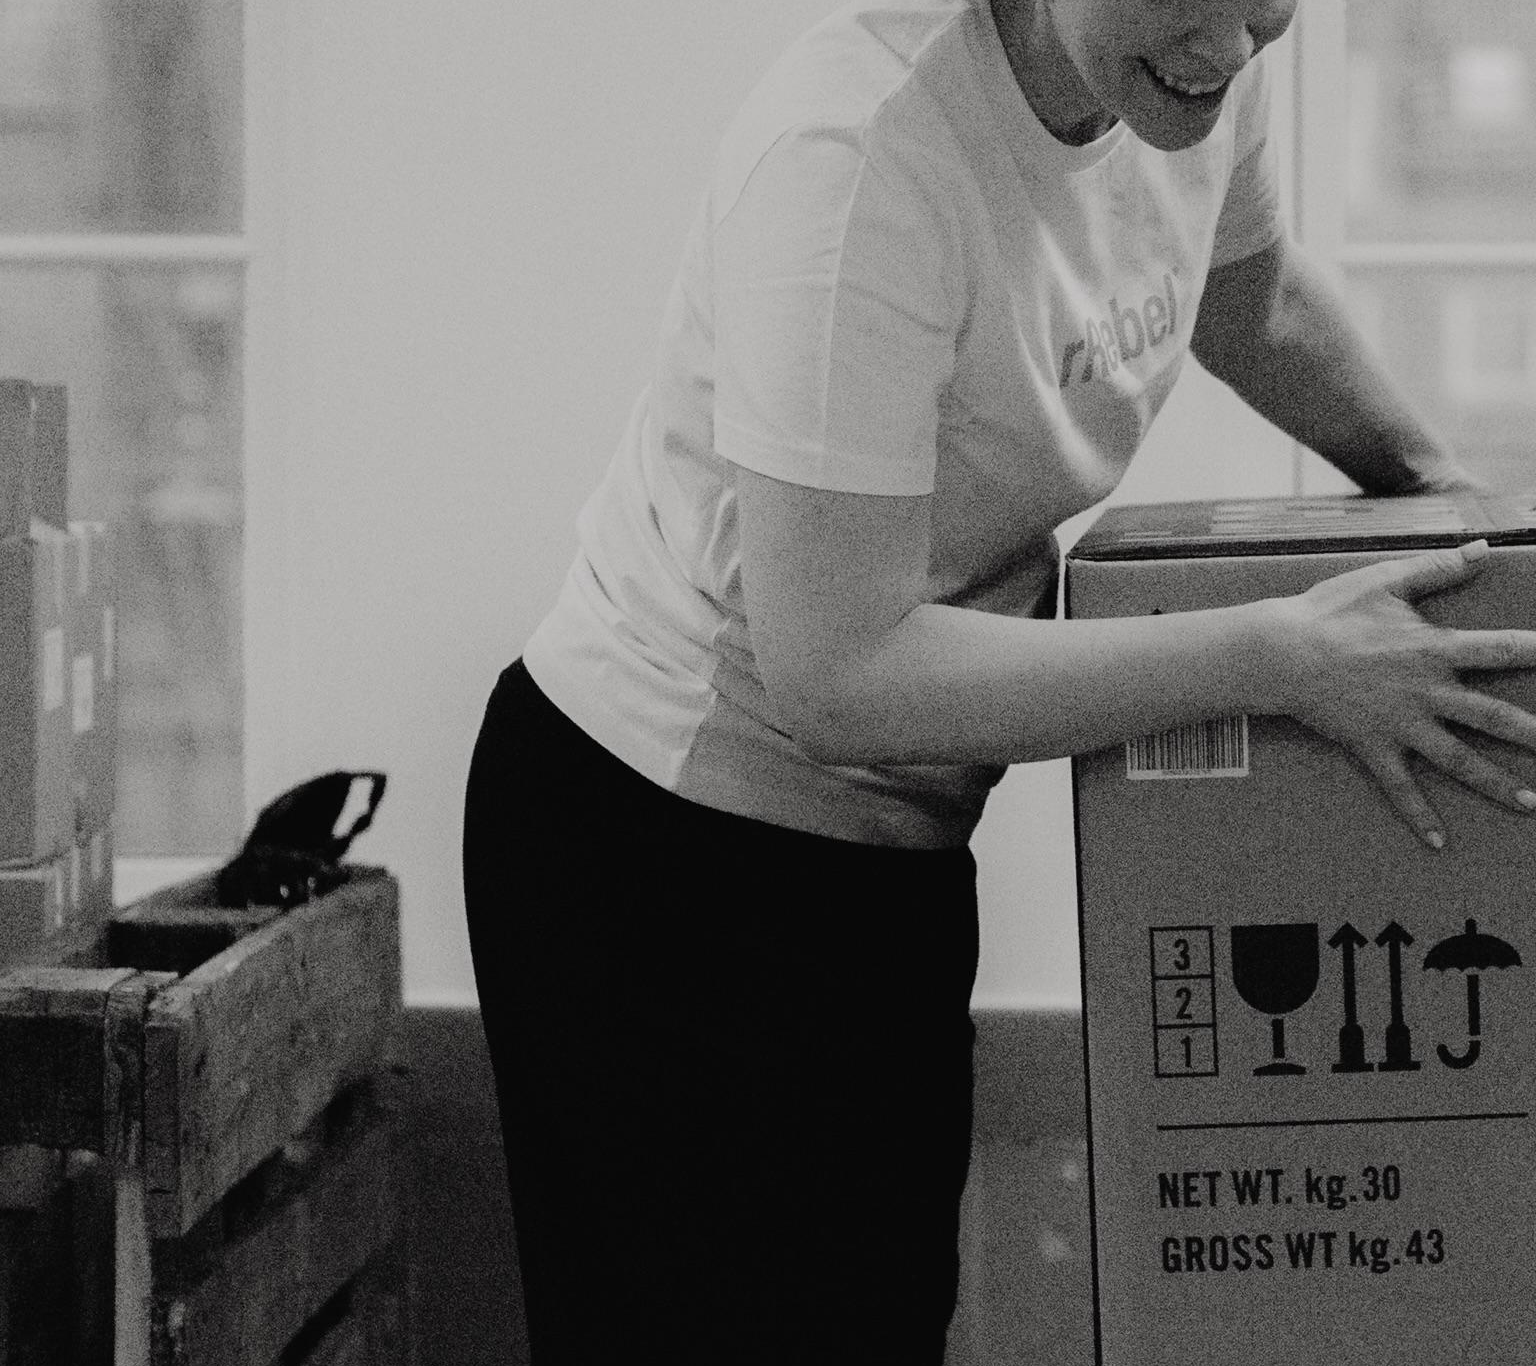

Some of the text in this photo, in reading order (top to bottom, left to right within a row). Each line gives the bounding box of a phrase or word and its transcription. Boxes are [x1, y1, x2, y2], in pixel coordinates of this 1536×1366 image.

[1174, 939, 1190, 970] 3
[1176, 987, 1192, 1019] 2
[1181, 1036, 1191, 1067] 1
[1158, 1165, 1400, 1210] NET WT. kg.30
[1162, 1229, 1444, 1274] GROSS WT kg.43
